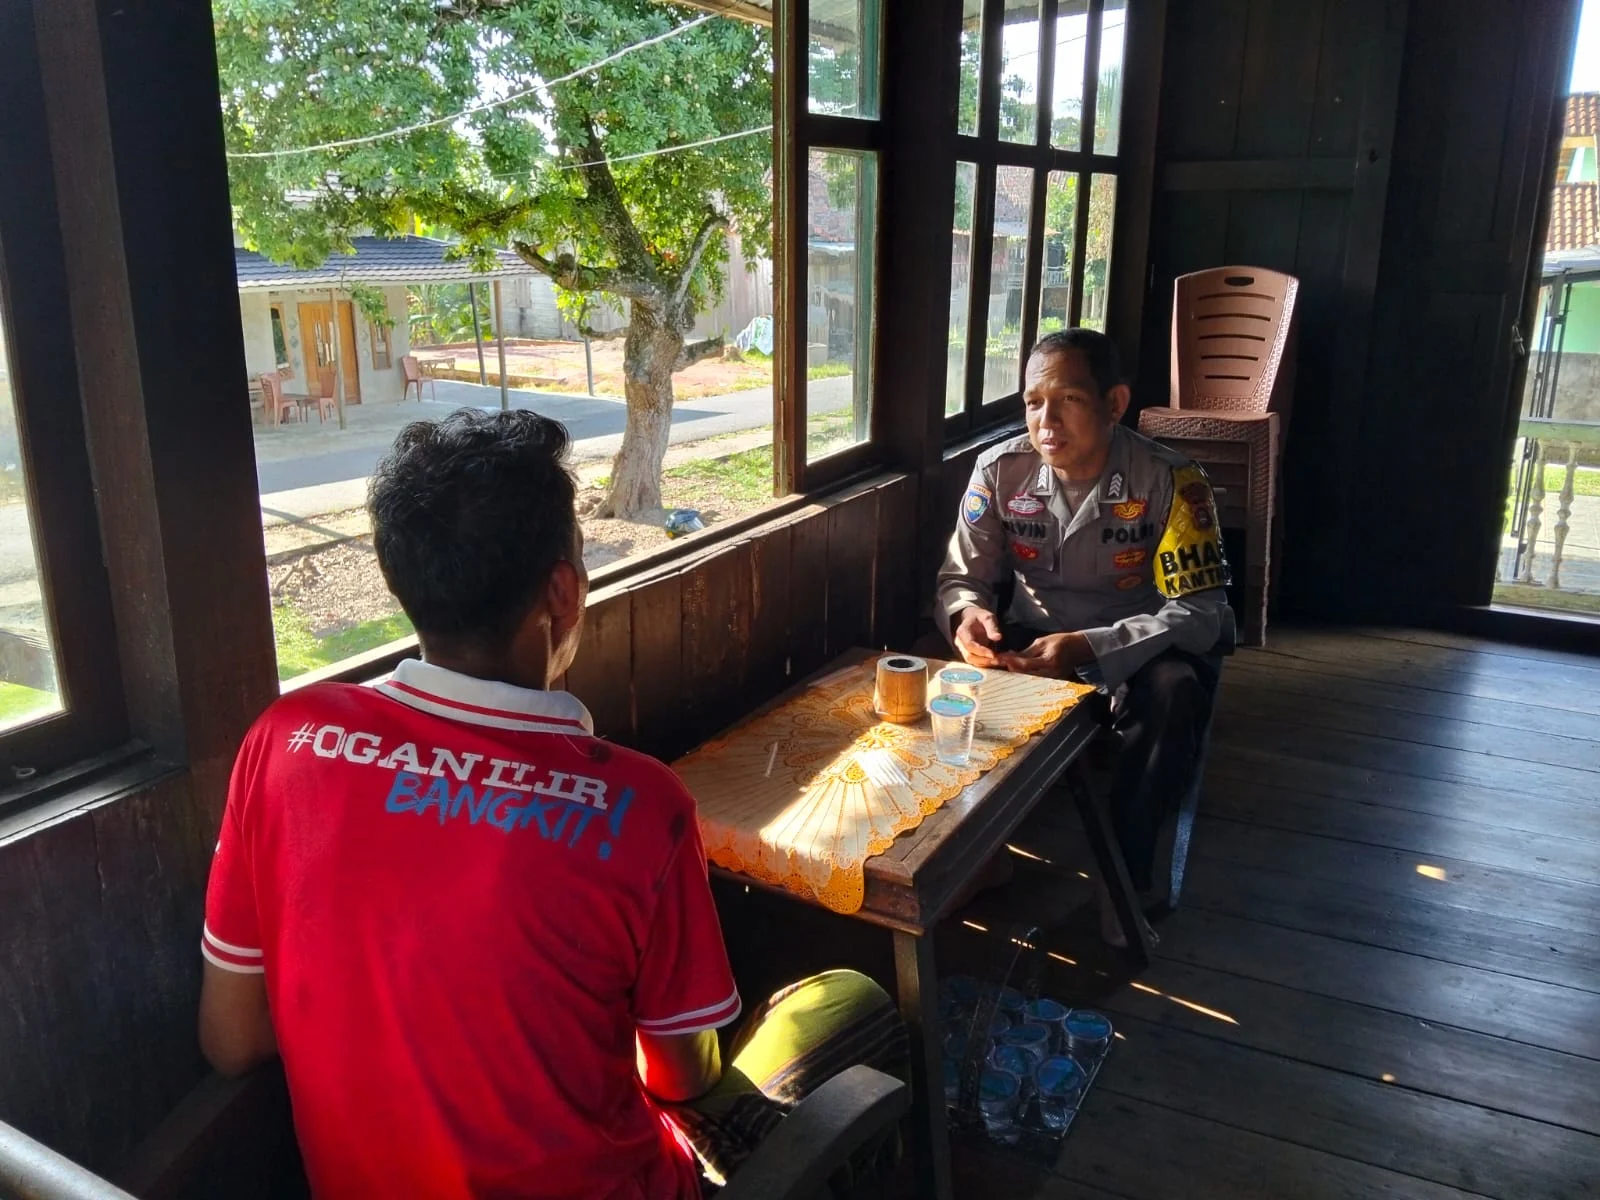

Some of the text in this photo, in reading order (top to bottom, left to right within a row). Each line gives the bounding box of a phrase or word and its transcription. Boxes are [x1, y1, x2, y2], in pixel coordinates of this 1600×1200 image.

[286, 722, 608, 809] #OGAN ILIR
[386, 771, 635, 860] BANGKIT!
